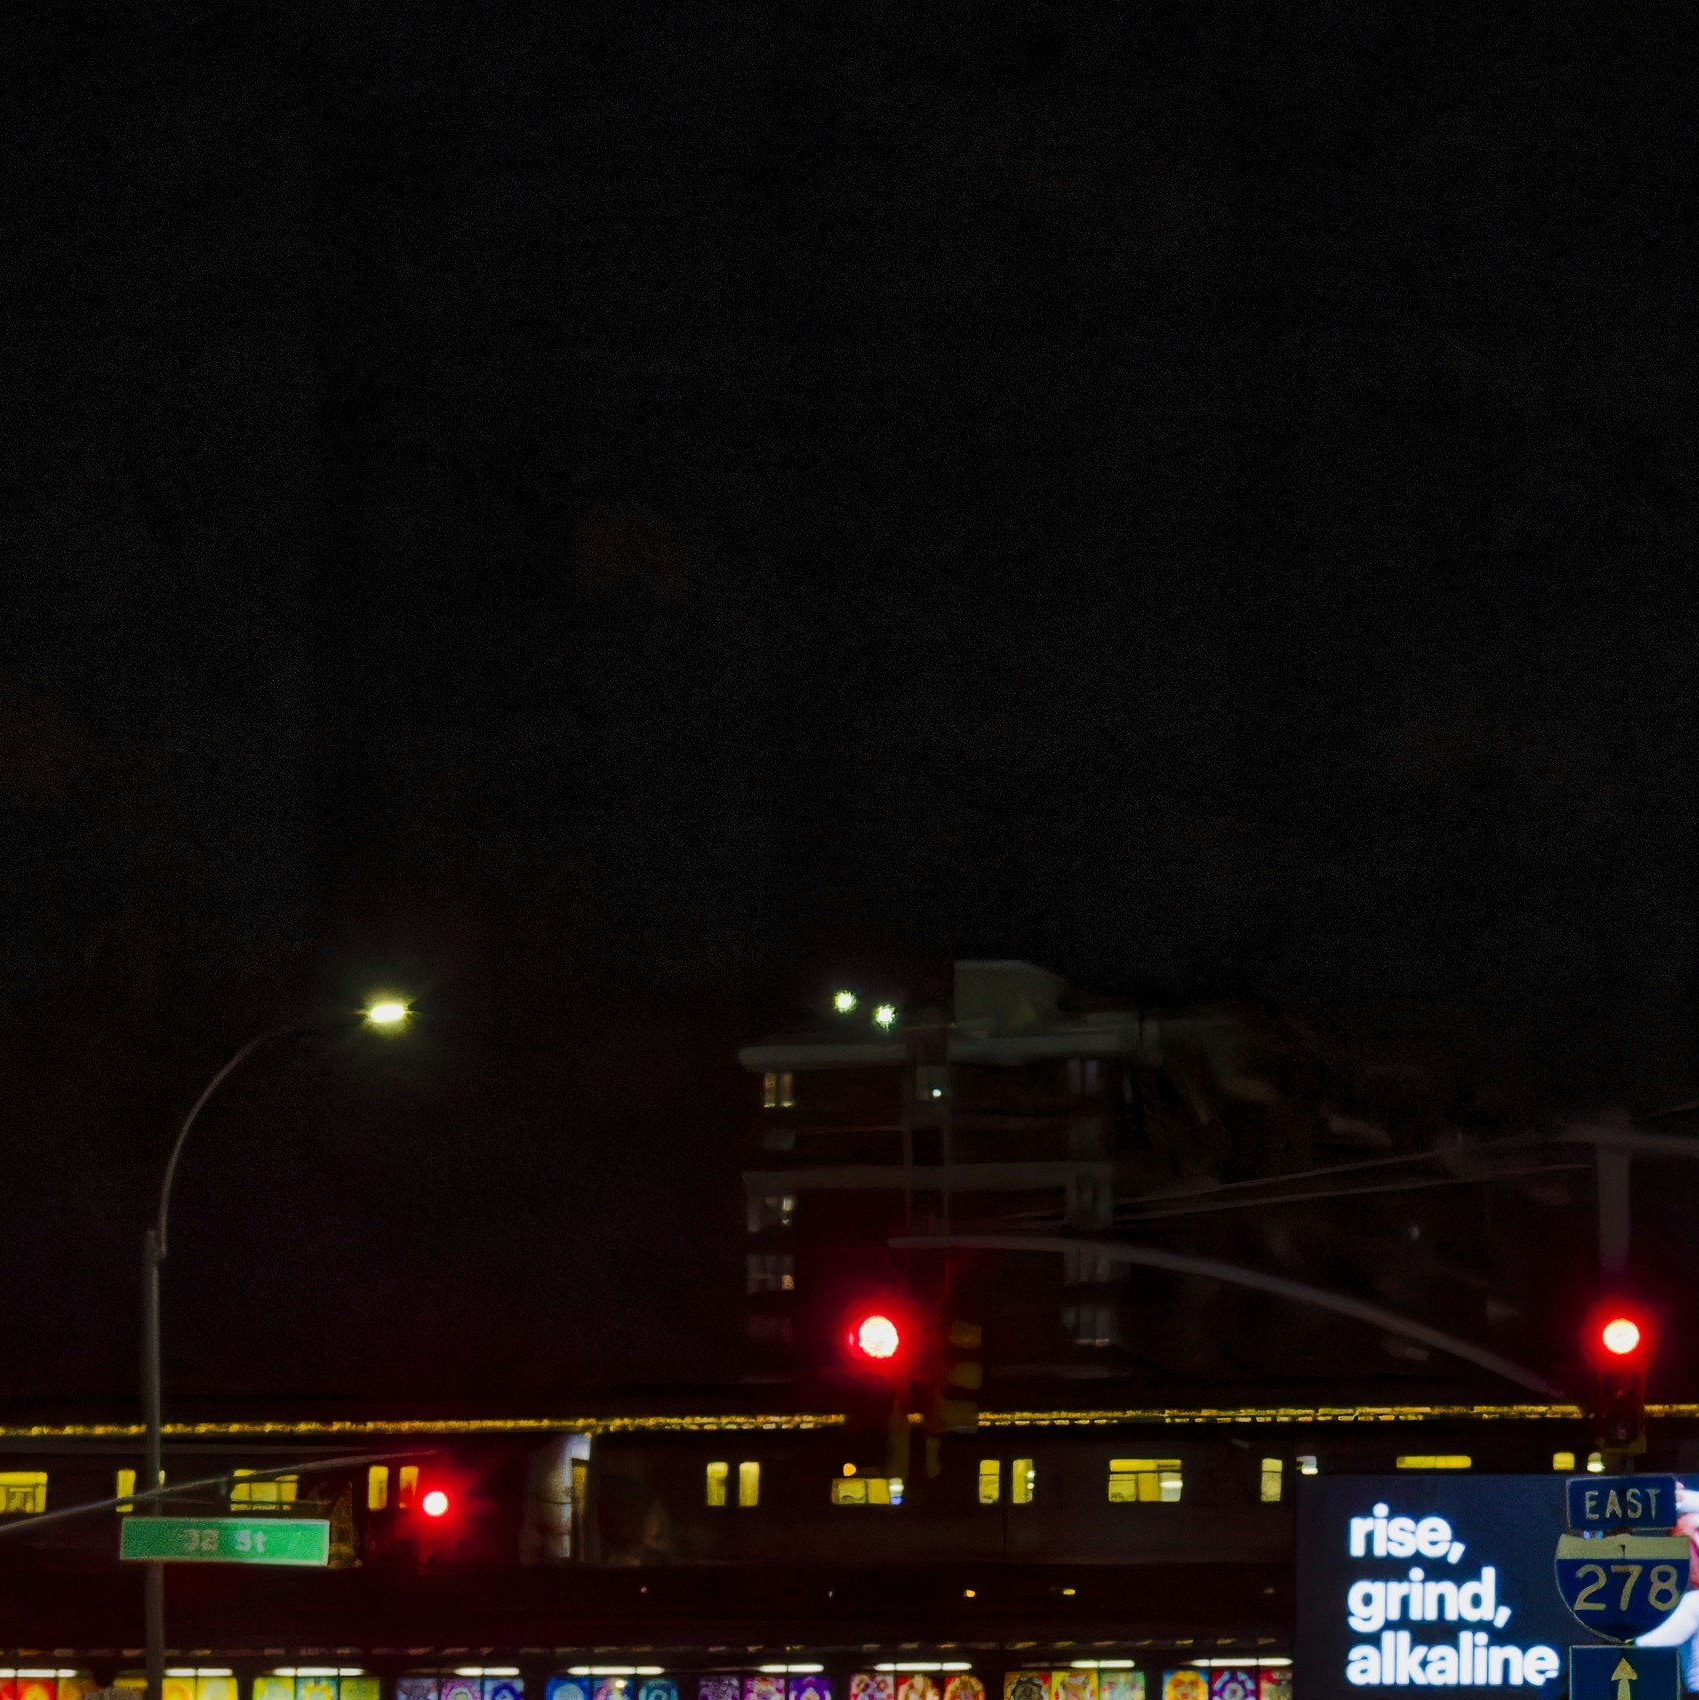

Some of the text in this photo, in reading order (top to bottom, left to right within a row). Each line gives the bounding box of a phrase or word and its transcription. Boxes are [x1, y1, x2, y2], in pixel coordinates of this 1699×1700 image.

[1584, 1488, 1661, 1520] EAST
[1348, 1503, 1466, 1565] rise,
[1346, 1566, 1512, 1633] grind,
[1573, 1563, 1679, 1612] 278
